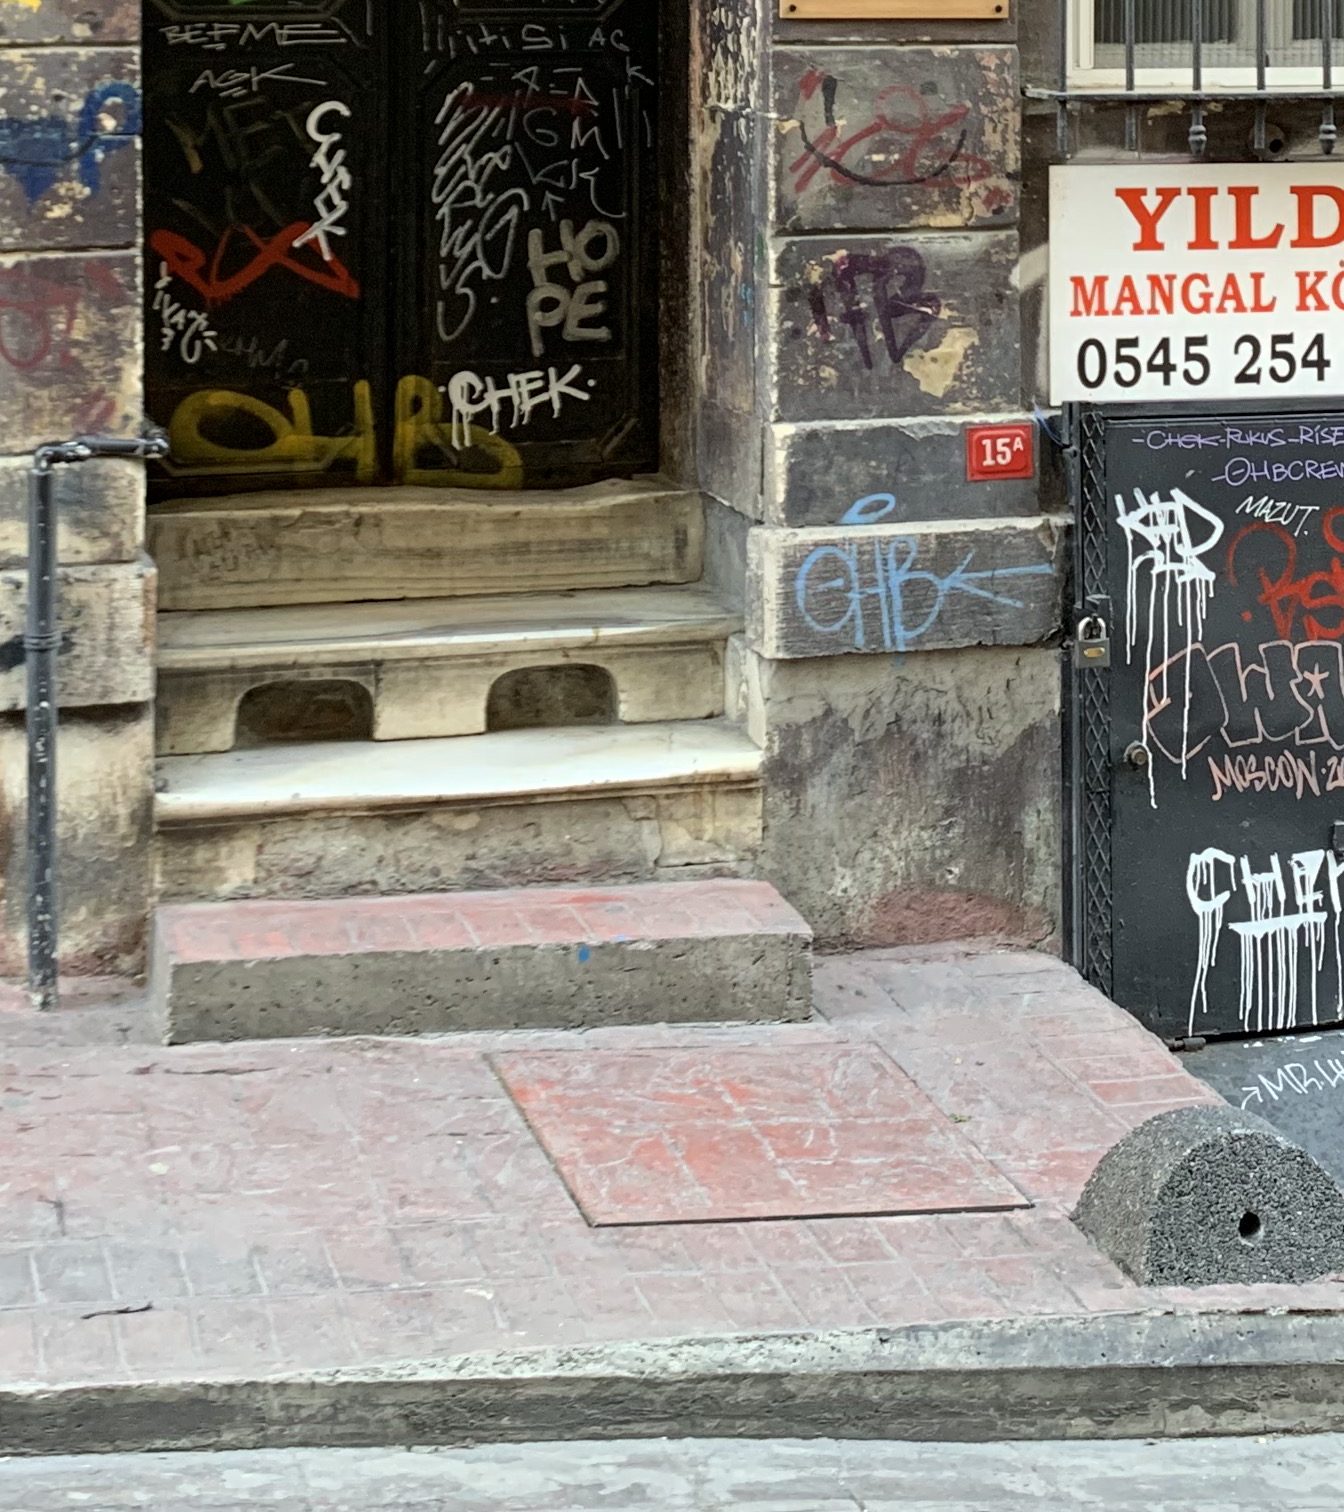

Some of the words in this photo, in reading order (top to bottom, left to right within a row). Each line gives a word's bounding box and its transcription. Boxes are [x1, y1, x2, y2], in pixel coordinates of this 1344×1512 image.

[1069, 272, 1277, 317] MANGAL
[1076, 335, 1211, 388] 0545
[1233, 332, 1331, 385] 254
